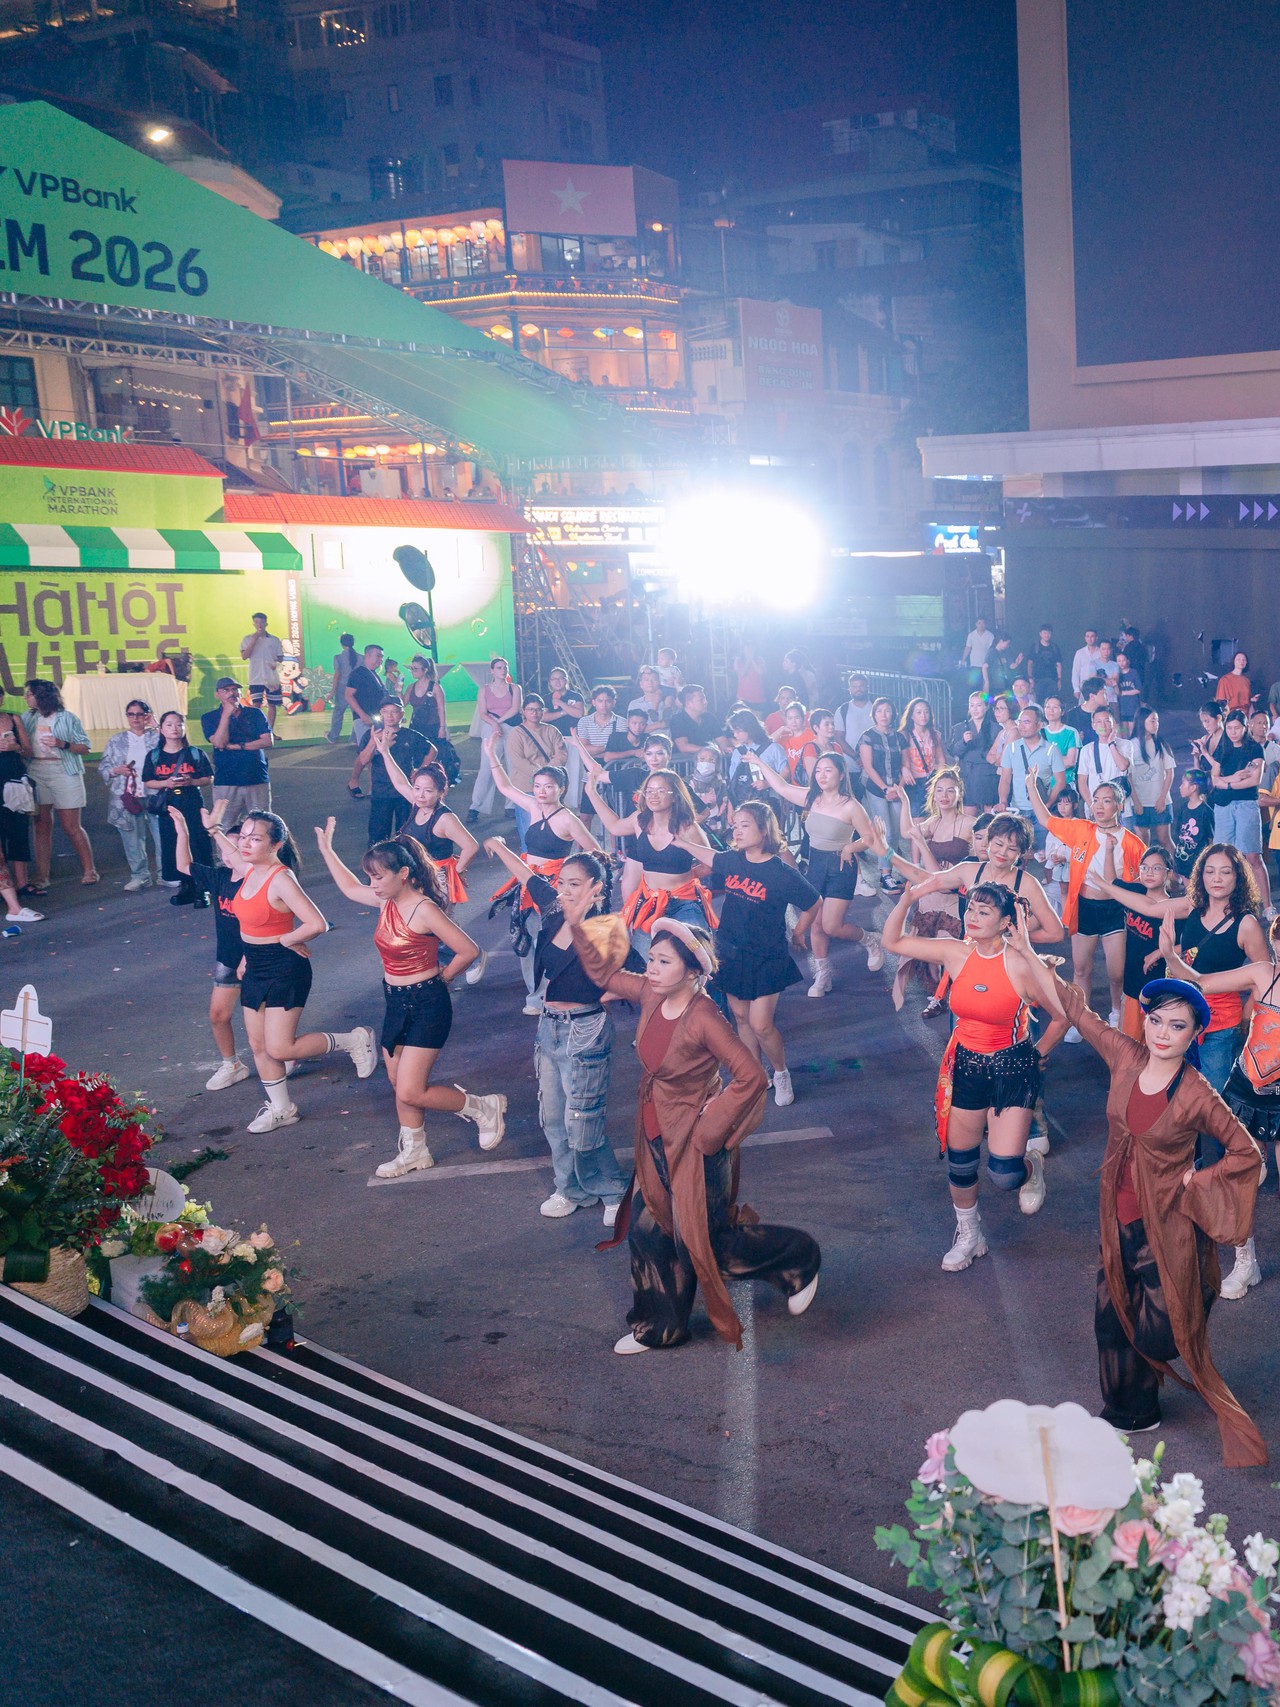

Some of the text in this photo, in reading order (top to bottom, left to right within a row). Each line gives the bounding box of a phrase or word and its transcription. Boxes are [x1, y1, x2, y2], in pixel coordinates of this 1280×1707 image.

[14, 168, 138, 214] VPBank
[69, 230, 209, 297] 2026
[36, 418, 134, 444] VPBank
[46, 495, 118, 506] INTERNATIONAL
[59, 486, 116, 498] VPBANK
[47, 503, 118, 515] MARATHON
